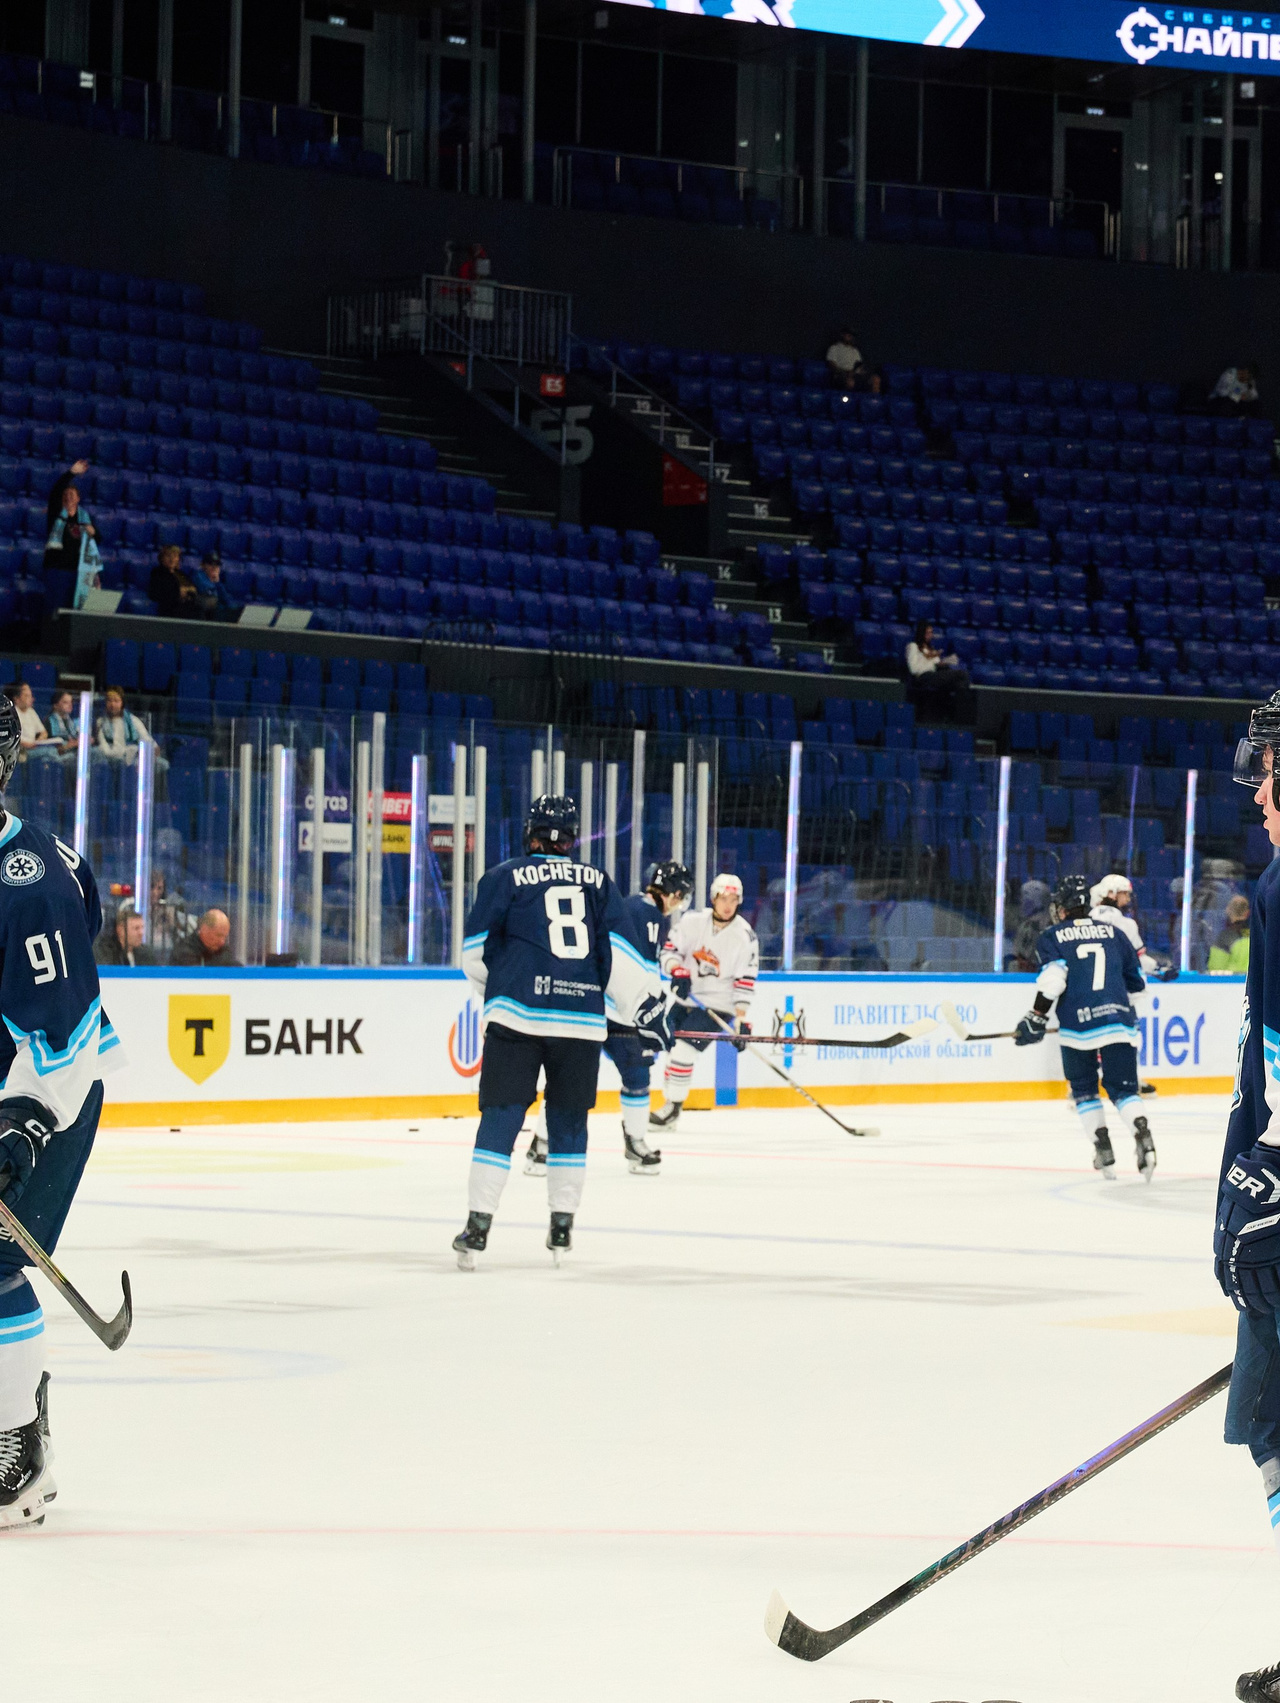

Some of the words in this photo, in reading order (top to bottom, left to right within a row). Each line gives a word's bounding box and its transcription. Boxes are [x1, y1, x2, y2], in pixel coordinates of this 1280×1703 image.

[512, 862, 605, 890] KOCHETOV
[543, 885, 591, 960] 8
[1055, 925, 1116, 944] KOKOREV
[25, 930, 68, 985] 91
[1076, 943, 1107, 991] 7
[833, 1003, 978, 1026] ПРАВИТЕЛЬСВО
[1137, 996, 1205, 1066] ier
[185, 1018, 214, 1056] Т
[245, 1018, 364, 1055] БАНК
[936, 1039, 993, 1058] области
